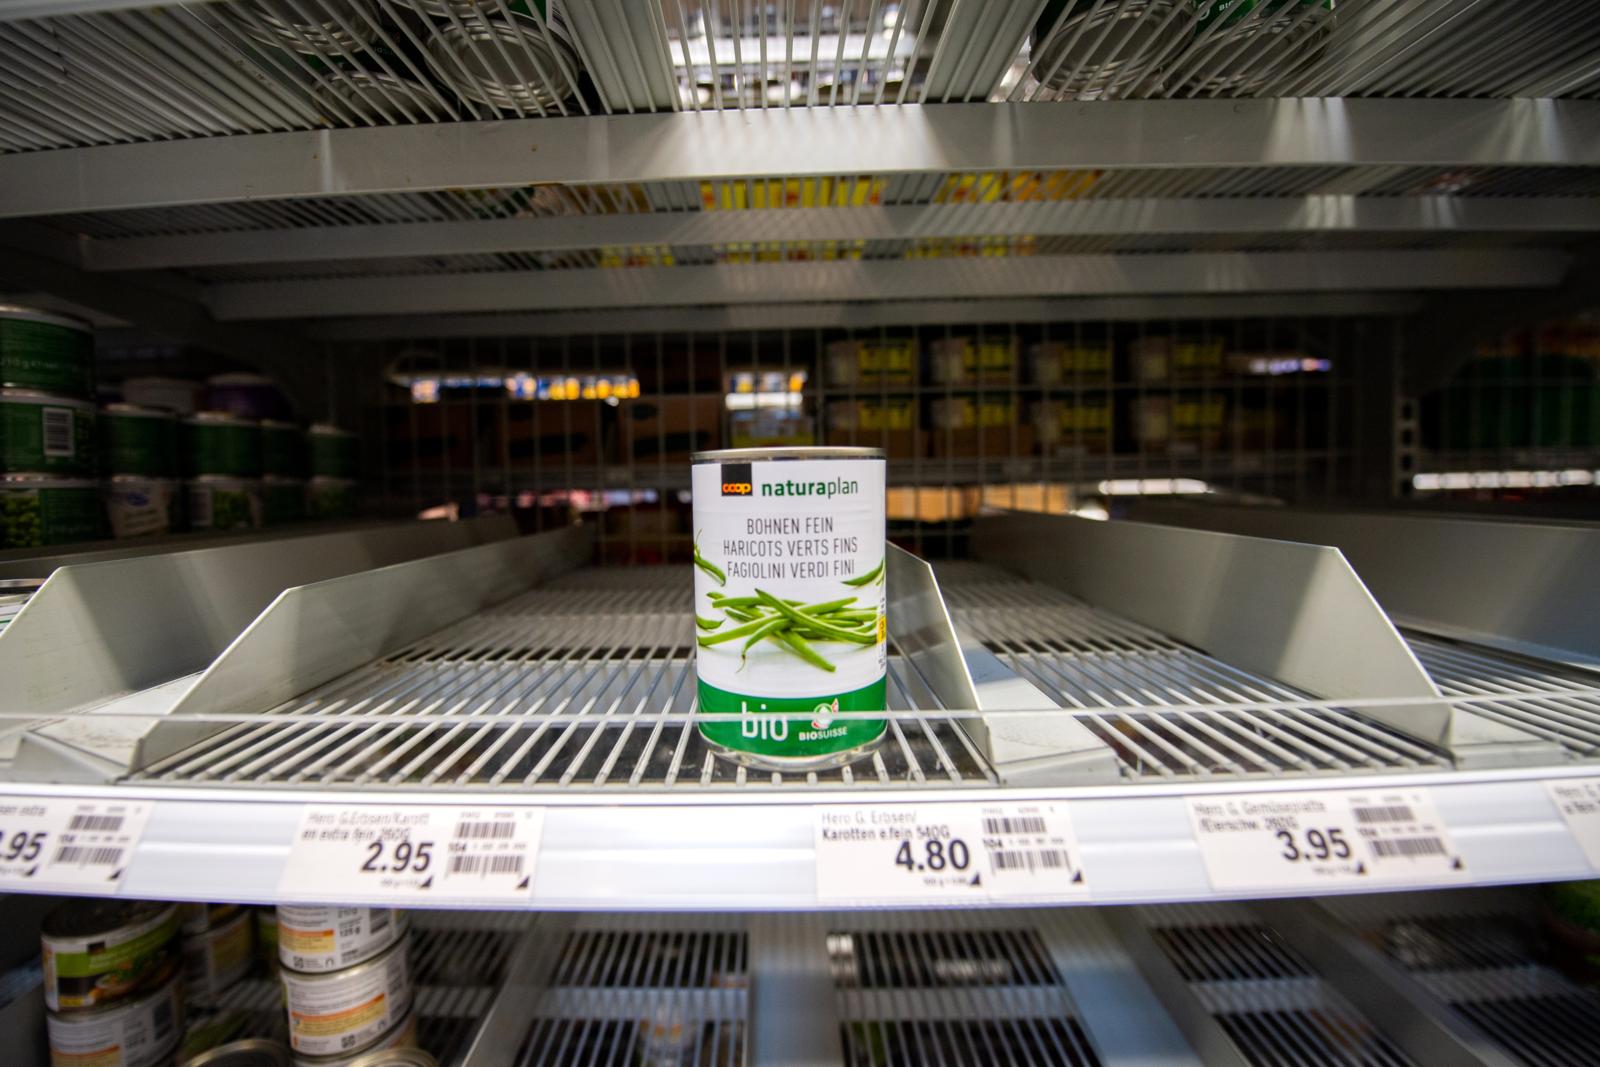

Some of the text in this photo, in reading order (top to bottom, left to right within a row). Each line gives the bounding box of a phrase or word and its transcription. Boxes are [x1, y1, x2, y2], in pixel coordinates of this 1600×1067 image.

[722, 483, 751, 495] coop
[761, 476, 858, 499] naturaplan
[747, 517, 833, 535] BOHNEN FEIN
[723, 536, 858, 557] HARICOTS VERTS FINS
[727, 559, 855, 579] FAGIOLINI VERDI FINI
[741, 701, 788, 741] bio
[821, 811, 853, 824] Hero
[822, 827, 876, 841] Karotten
[1275, 828, 1352, 861] 3.95
[0, 831, 48, 862] .95
[360, 841, 435, 872] 2.95
[895, 839, 970, 871] 4.80
